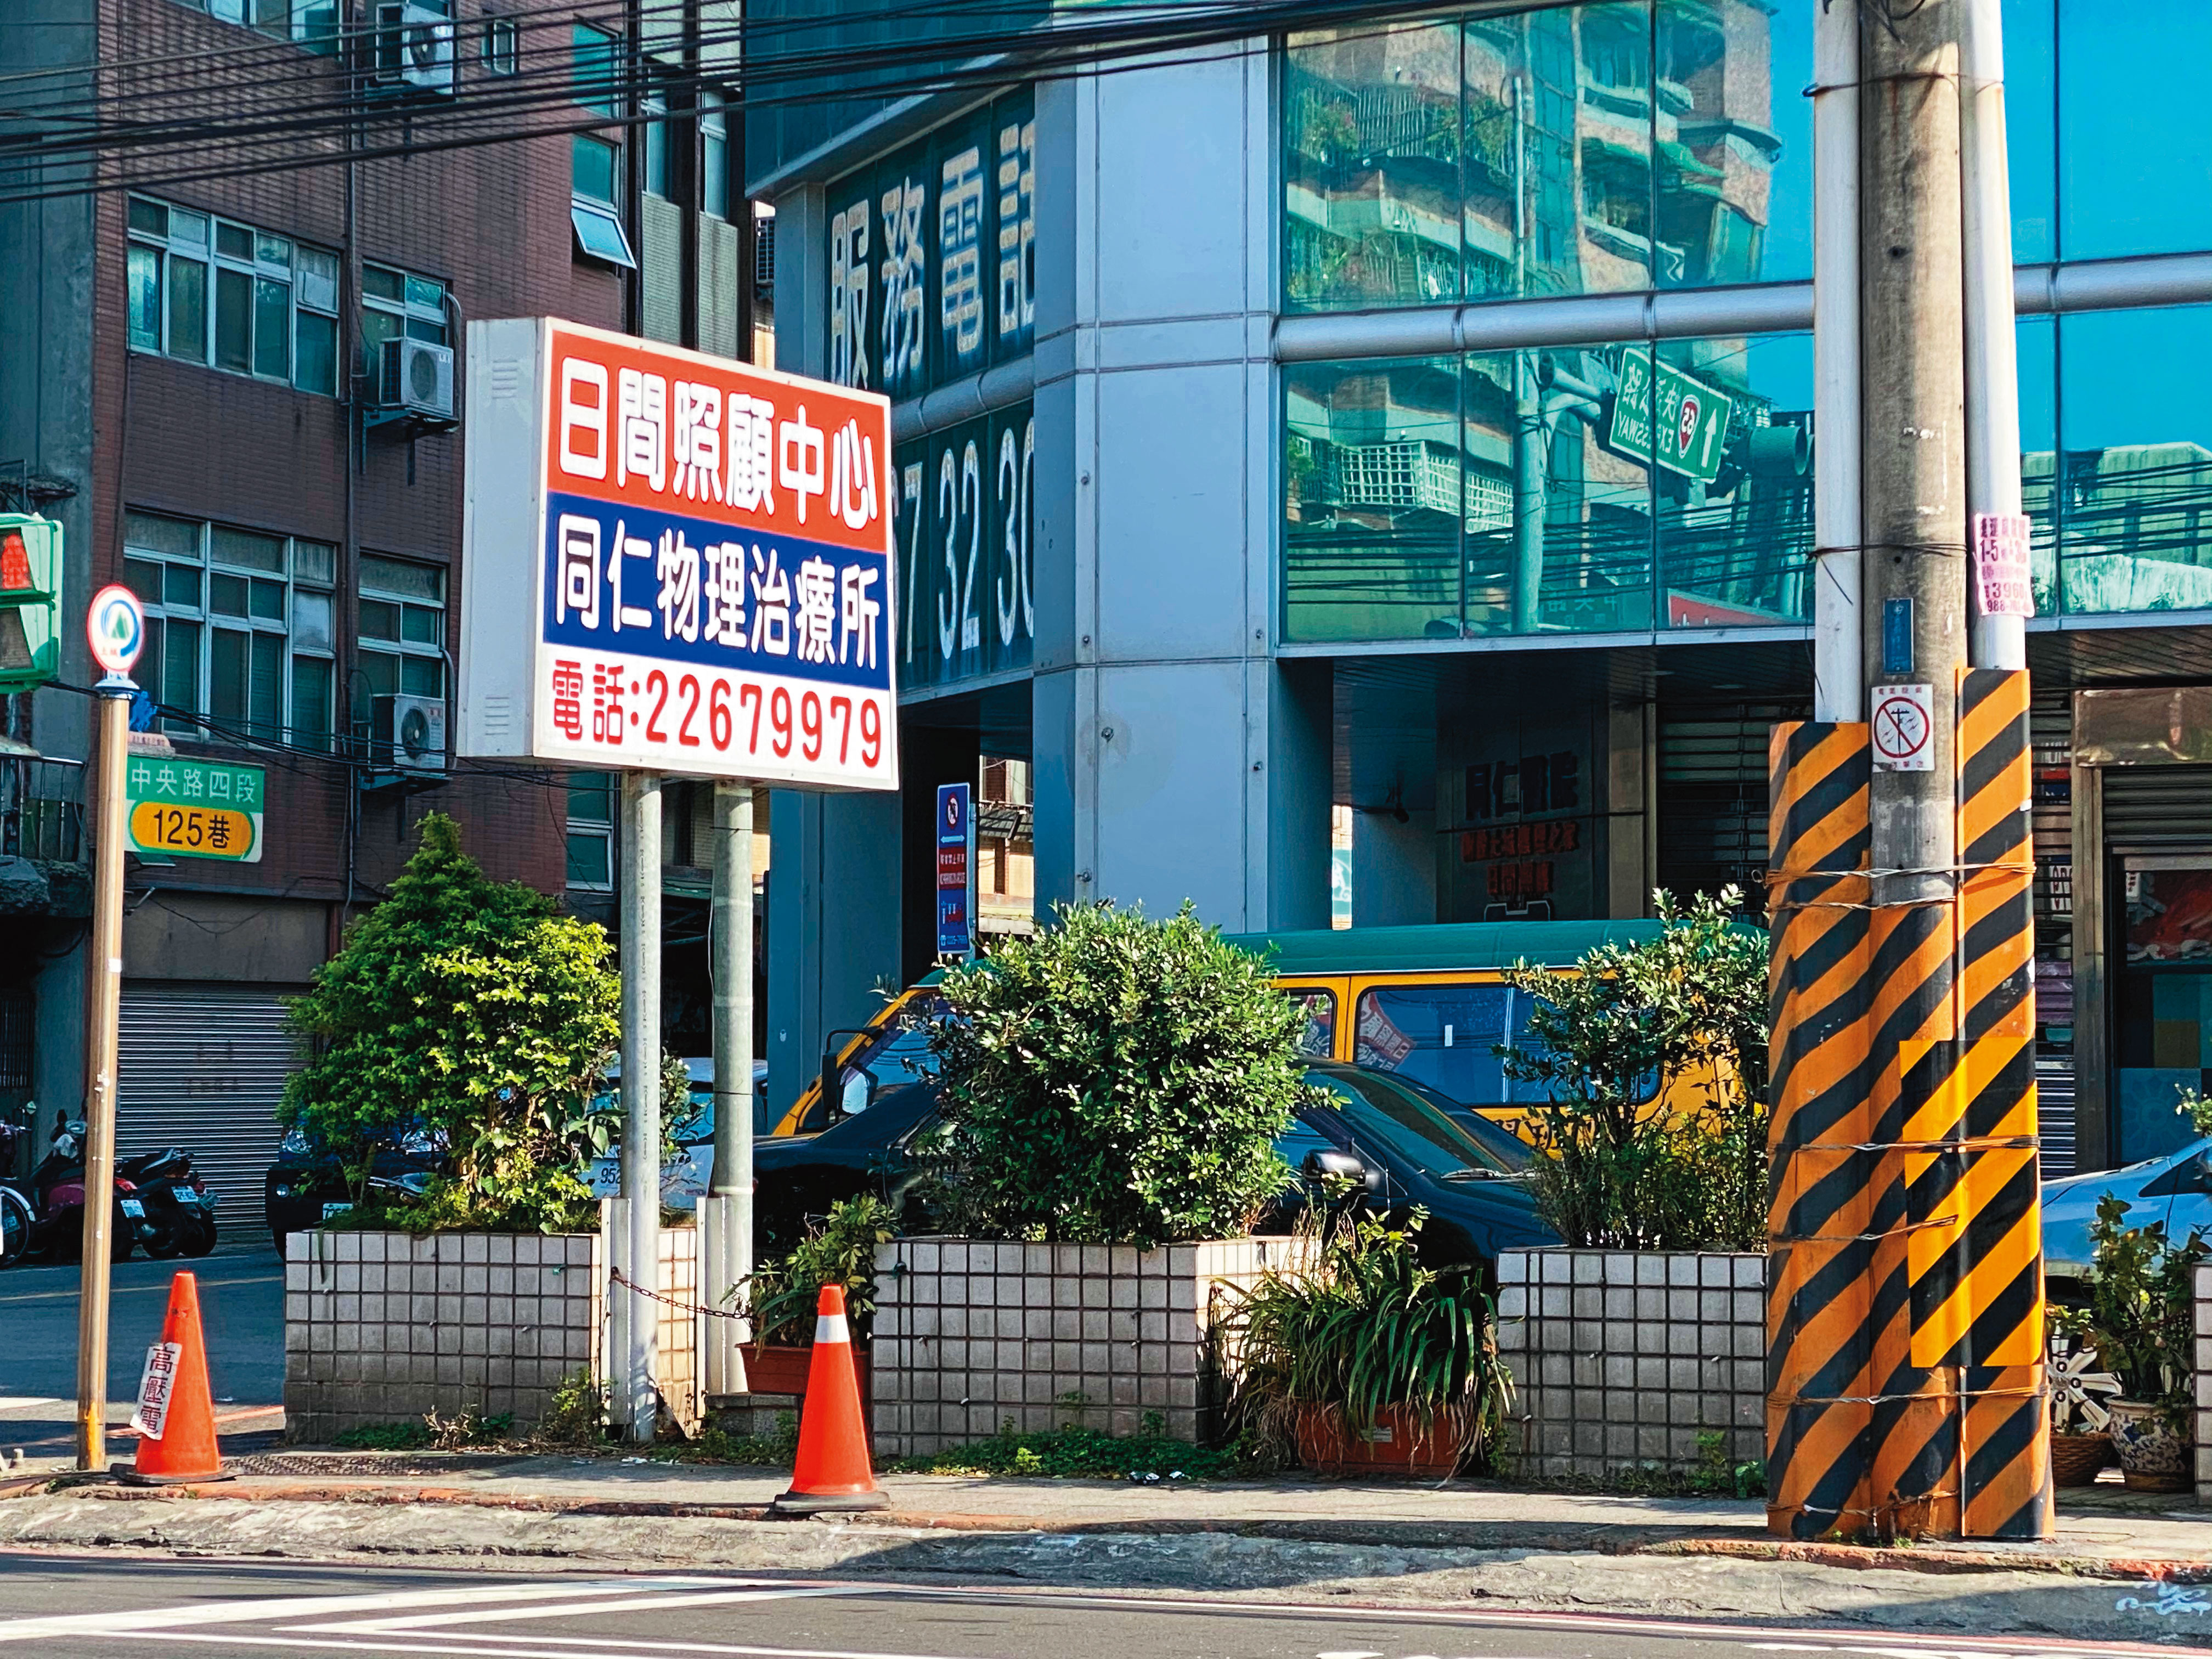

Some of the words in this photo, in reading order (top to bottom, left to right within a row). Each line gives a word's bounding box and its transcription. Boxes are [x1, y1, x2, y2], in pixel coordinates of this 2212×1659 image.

[831, 122, 1035, 391] 服務電話
[560, 356, 878, 530] 日間照顧中心
[556, 512, 880, 670] 同仁物理治療所
[131, 761, 256, 804] 中央路四段
[153, 809, 231, 849] 125巷
[140, 1343, 175, 1434] 高壓電
